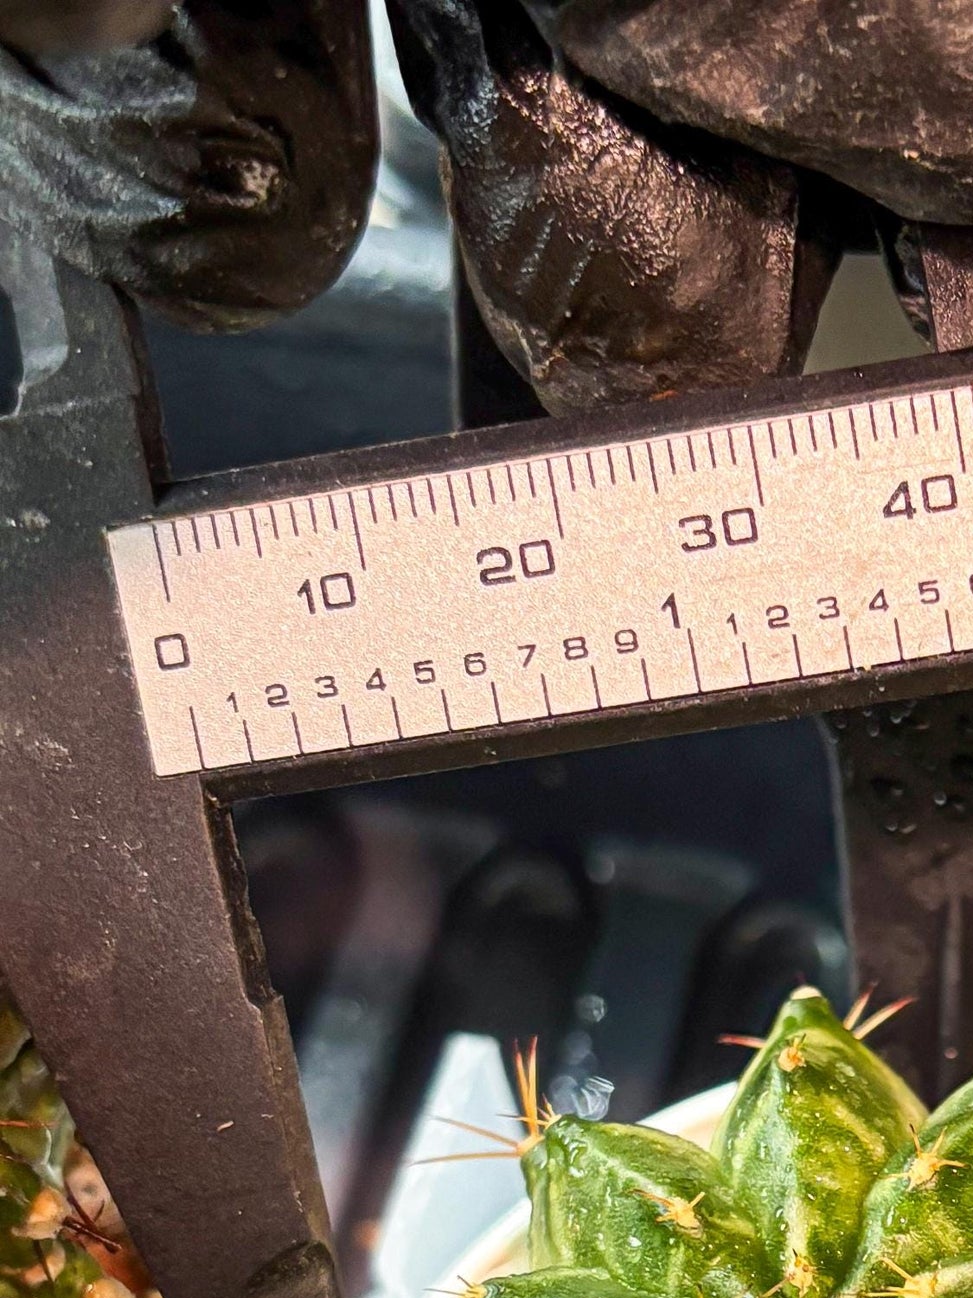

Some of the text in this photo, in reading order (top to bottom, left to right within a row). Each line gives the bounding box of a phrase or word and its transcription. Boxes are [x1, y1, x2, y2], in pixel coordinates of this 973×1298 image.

[154, 632, 191, 672] 0
[296, 571, 357, 615] 10
[476, 538, 557, 586] 20
[678, 506, 759, 553] 30
[882, 474, 959, 521] 40
[226, 690, 241, 713] 1
[264, 683, 290, 709] 2
[314, 675, 340, 699] 3
[365, 666, 388, 691] 4
[413, 659, 436, 684] 5
[463, 652, 487, 677] 6
[516, 643, 538, 669] 7
[562, 635, 589, 661] 8
[613, 628, 639, 654] 9
[660, 591, 682, 630] 1
[725, 611, 738, 635] 1
[765, 603, 791, 629] 2
[817, 596, 842, 621] 3
[867, 588, 890, 613] 4
[917, 579, 941, 605] 5
